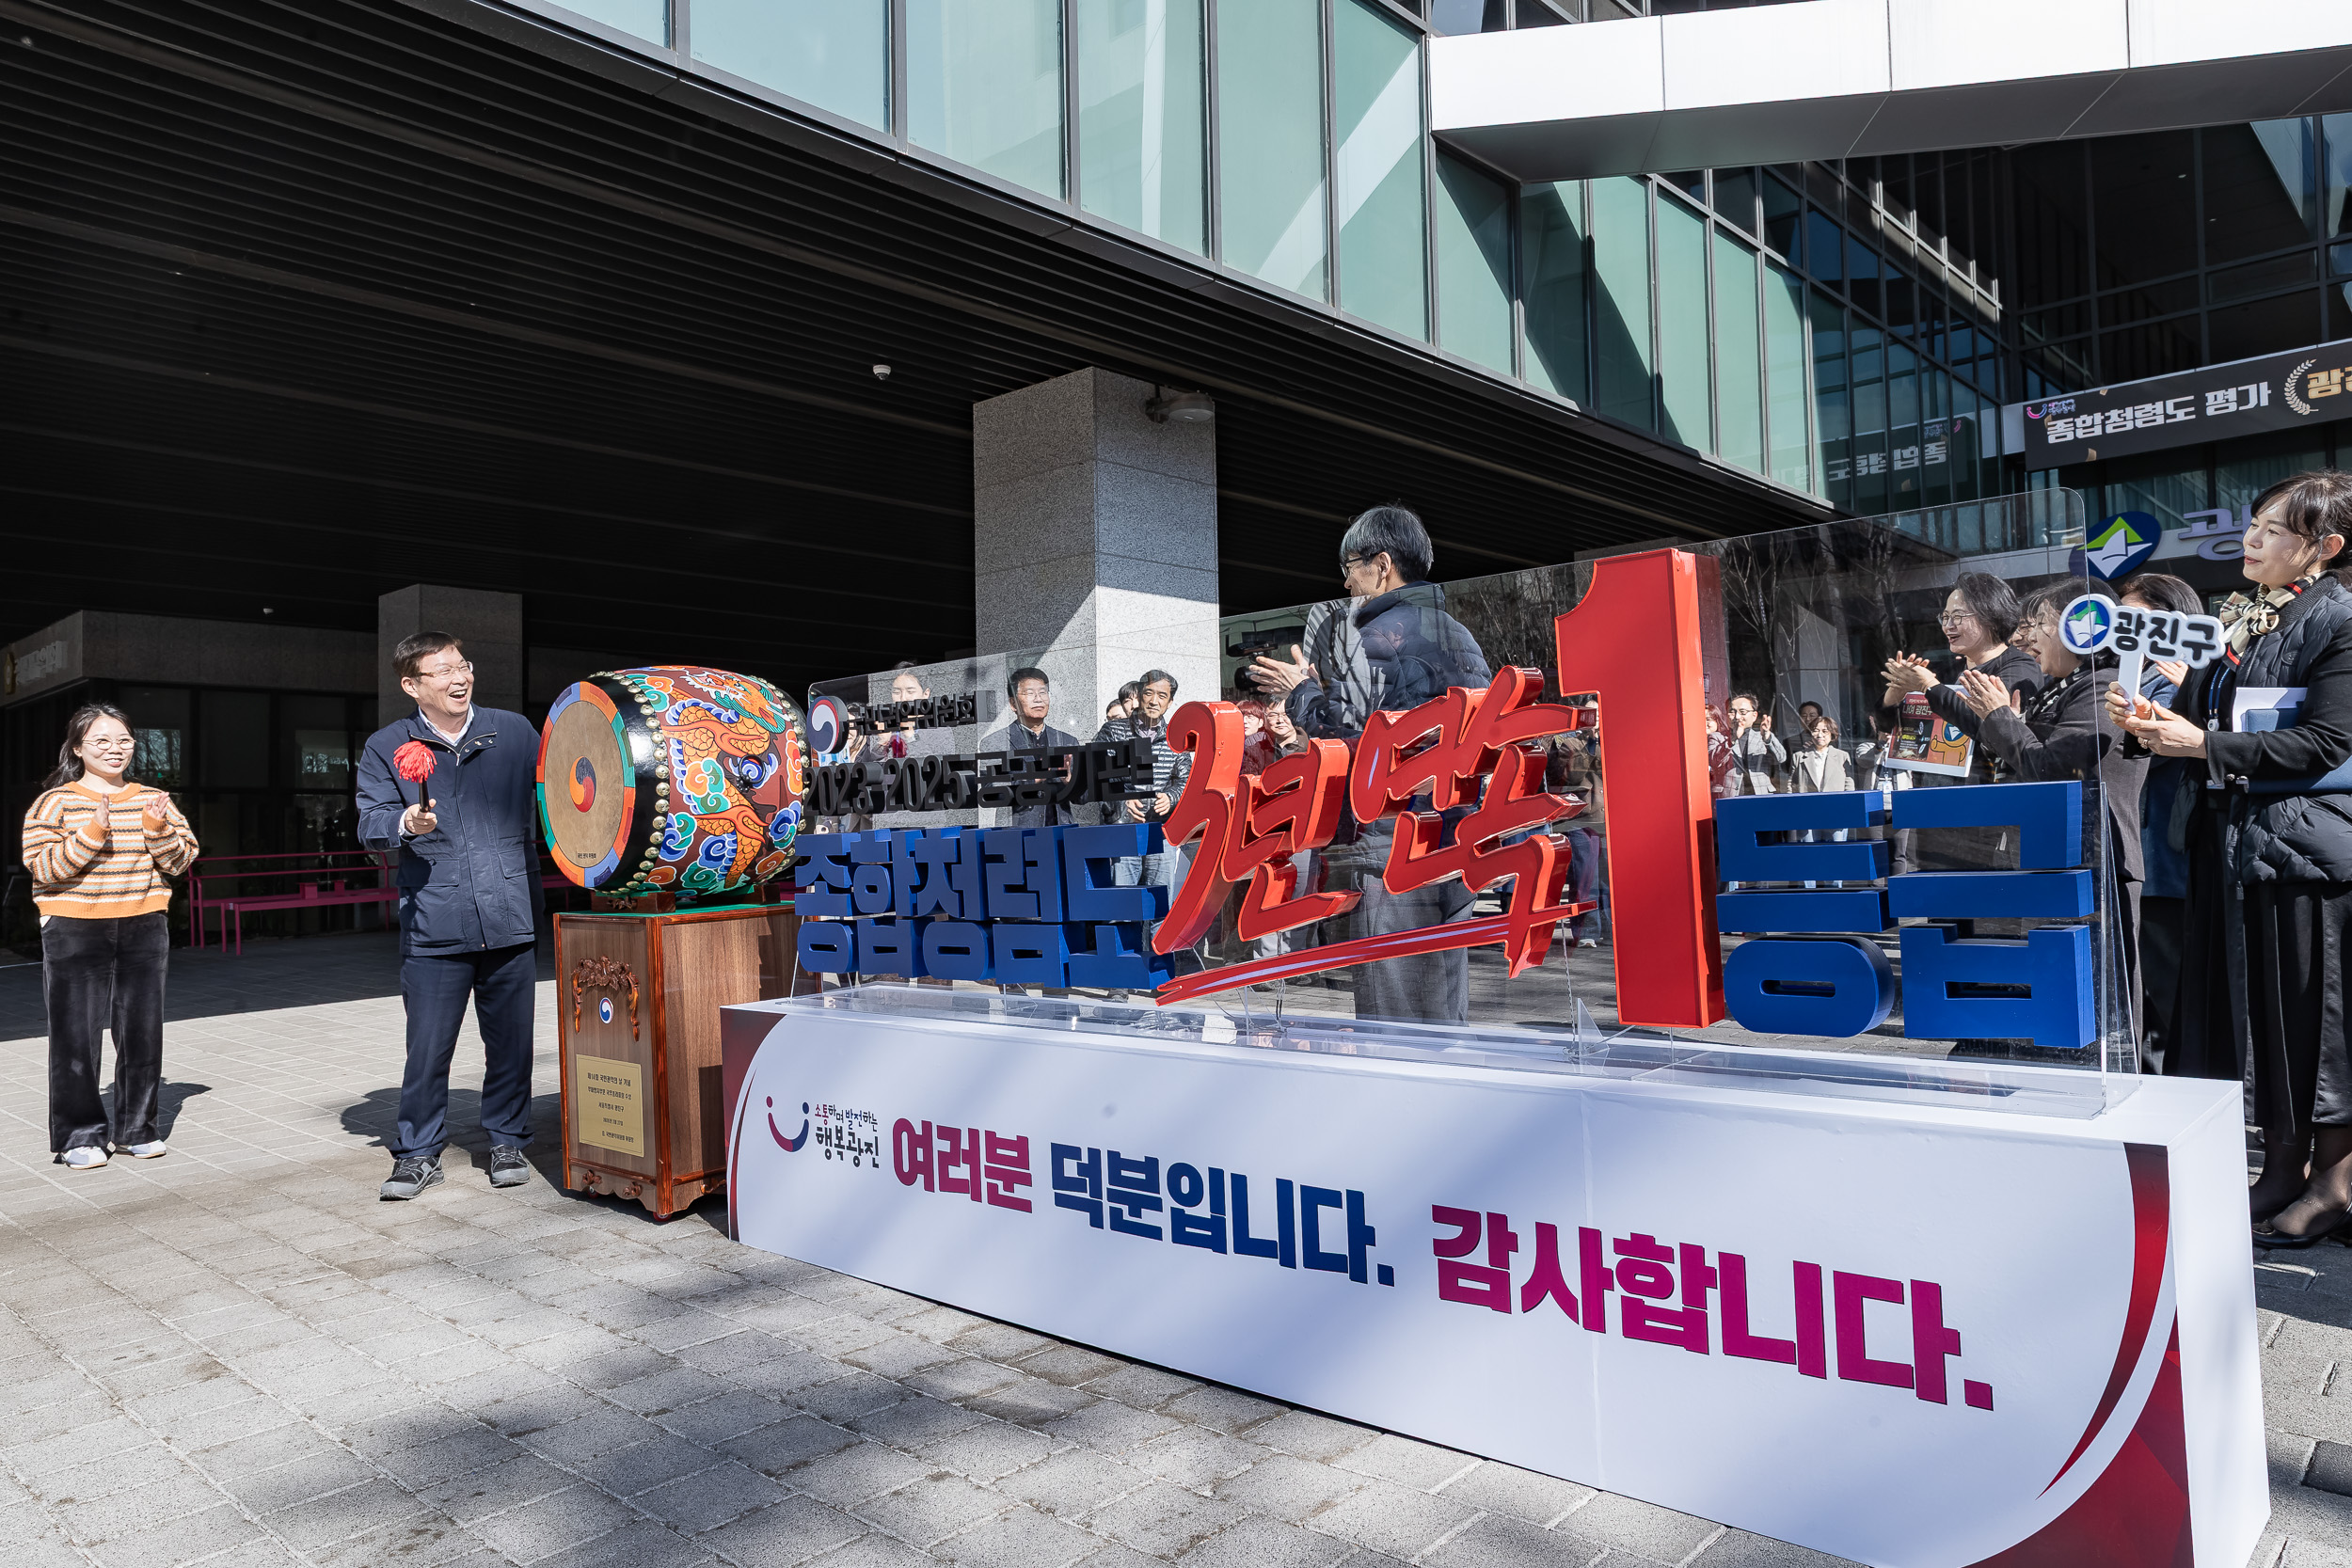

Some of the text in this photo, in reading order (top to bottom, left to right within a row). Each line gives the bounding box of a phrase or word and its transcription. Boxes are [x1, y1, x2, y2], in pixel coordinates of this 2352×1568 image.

[2047, 395, 2196, 444] 종합청렴도
[2205, 381, 2272, 417] 평가
[2307, 366, 2352, 399] 광
[2114, 610, 2216, 660] 광진구
[976, 738, 1158, 809] 공공기관
[794, 822, 1175, 989] 종합청렴도
[814, 1103, 879, 1132] 소통하며 발전하는
[815, 1124, 880, 1169] 행복광진
[892, 1117, 1994, 1411] 여러분 덕분입니다. 감사합니다.
